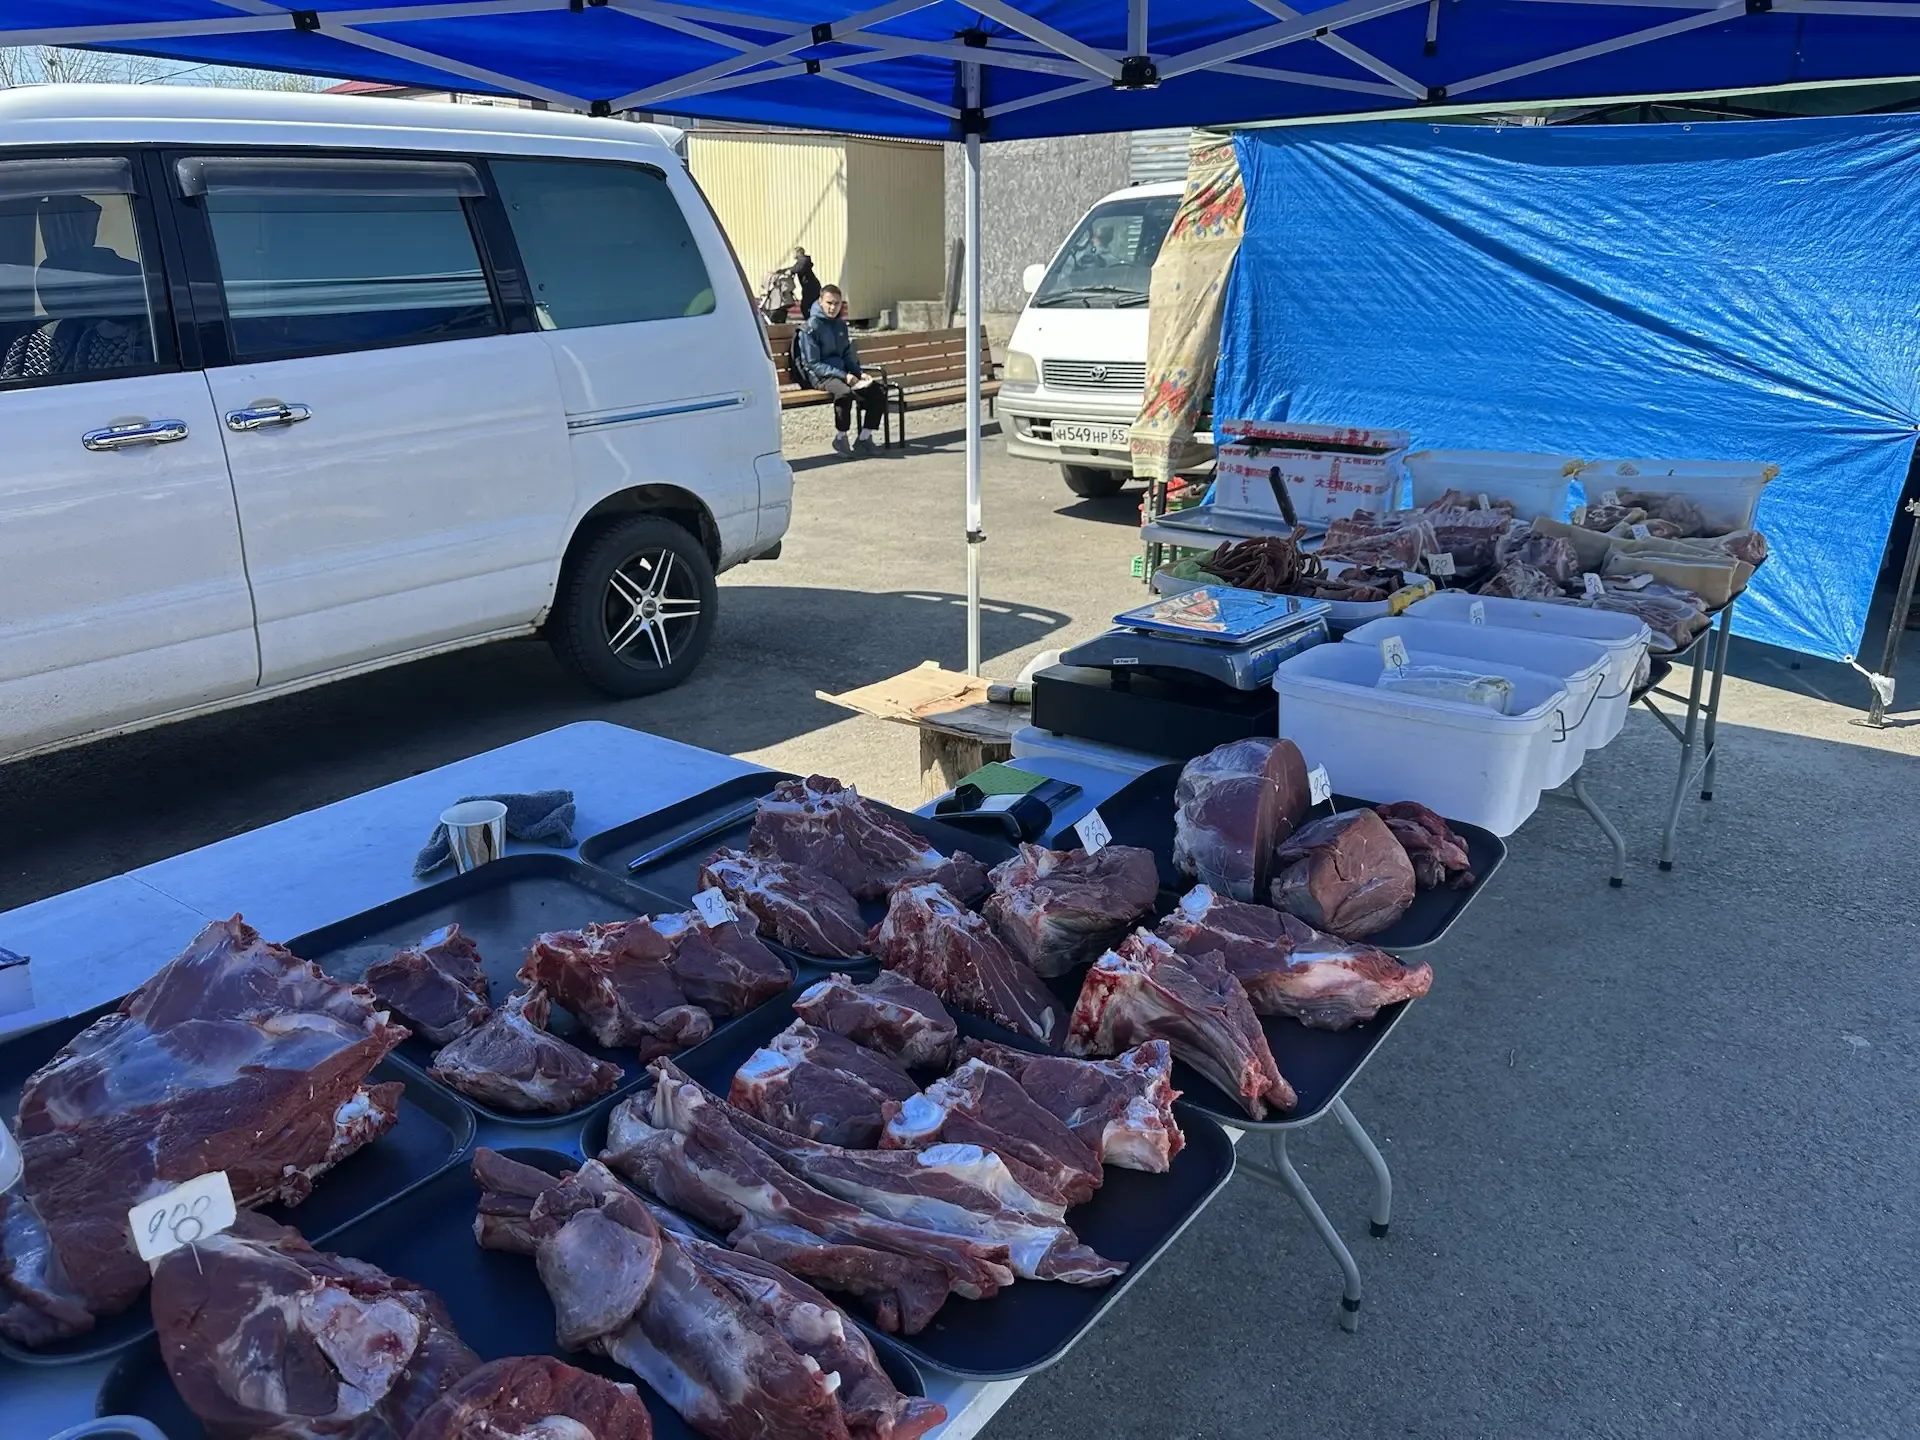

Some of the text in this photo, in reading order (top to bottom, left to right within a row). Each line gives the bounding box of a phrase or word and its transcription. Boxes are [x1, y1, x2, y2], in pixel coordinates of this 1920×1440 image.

[1111, 429, 1125, 441] 65
[1084, 818, 1102, 842] 950
[148, 1195, 211, 1243] 900
